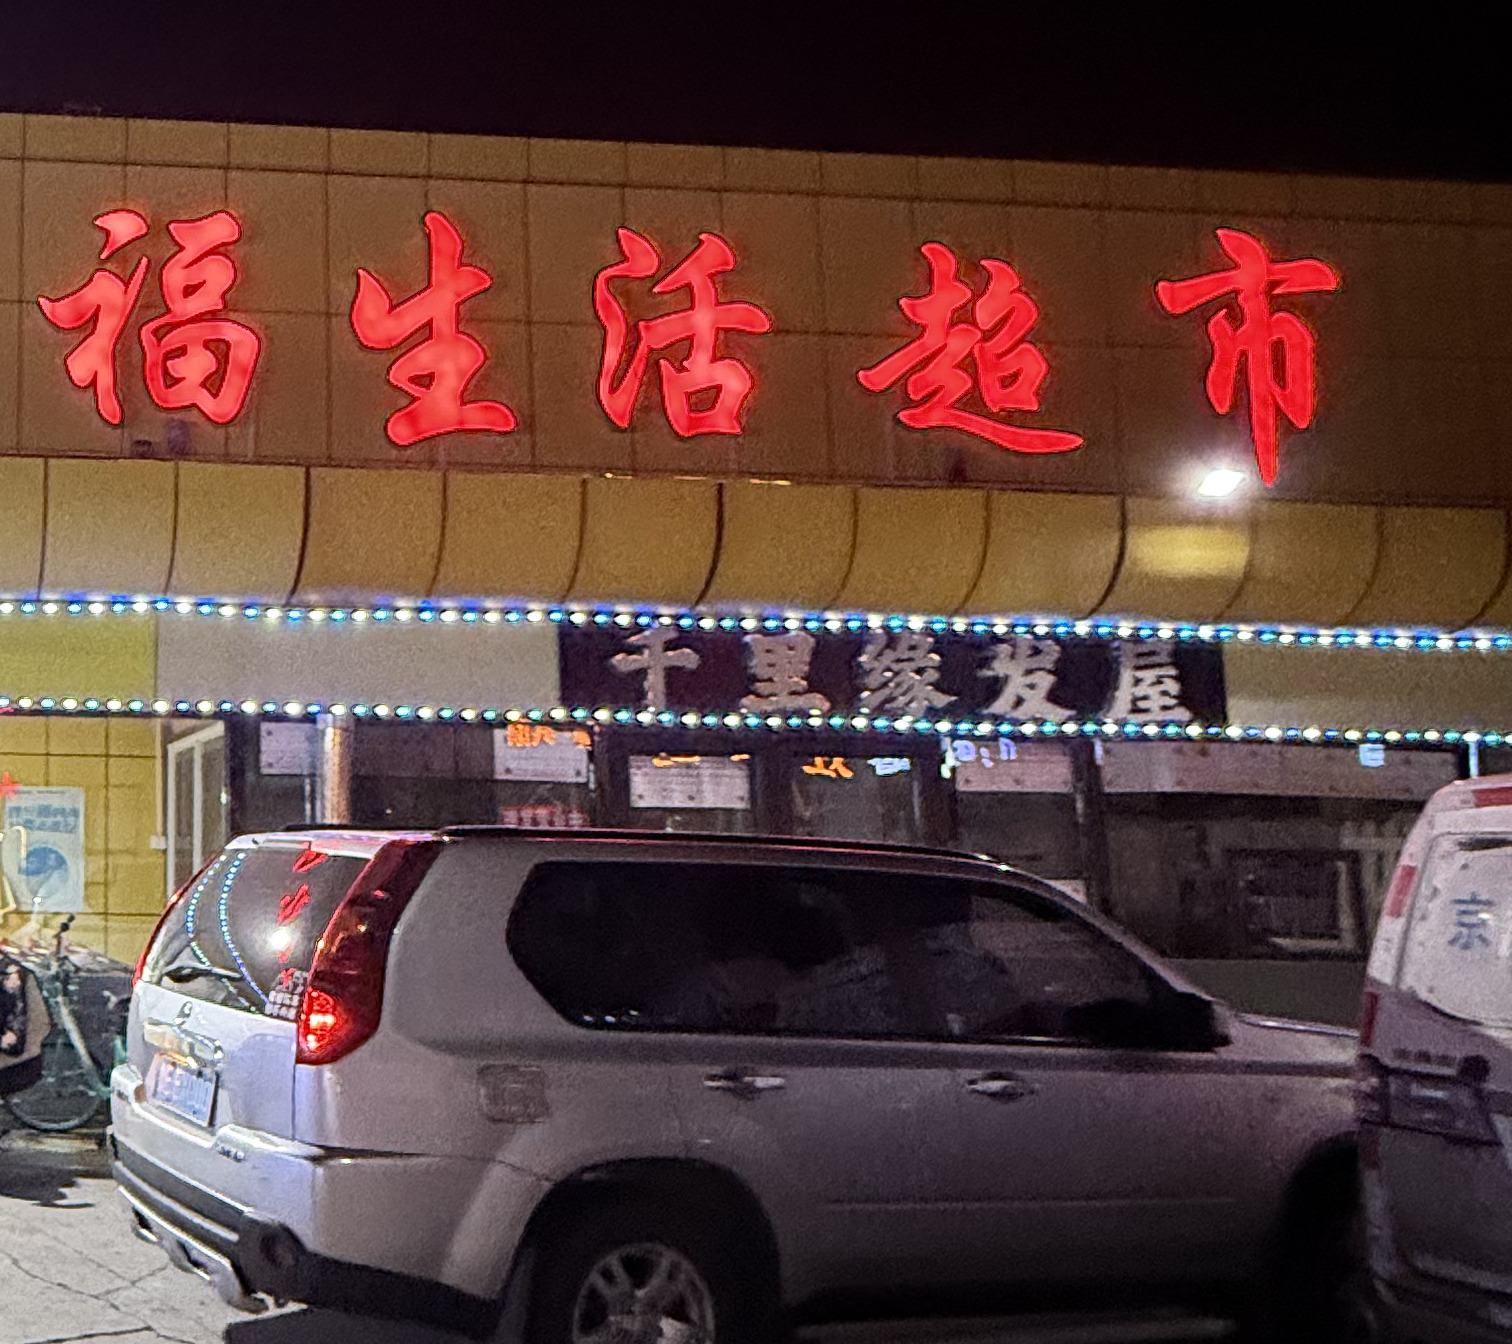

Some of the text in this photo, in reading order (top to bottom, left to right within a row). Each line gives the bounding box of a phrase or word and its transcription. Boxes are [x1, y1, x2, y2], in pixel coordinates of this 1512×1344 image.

[611, 628, 1191, 724] 千里缘发屋
[1446, 891, 1497, 950] 京
